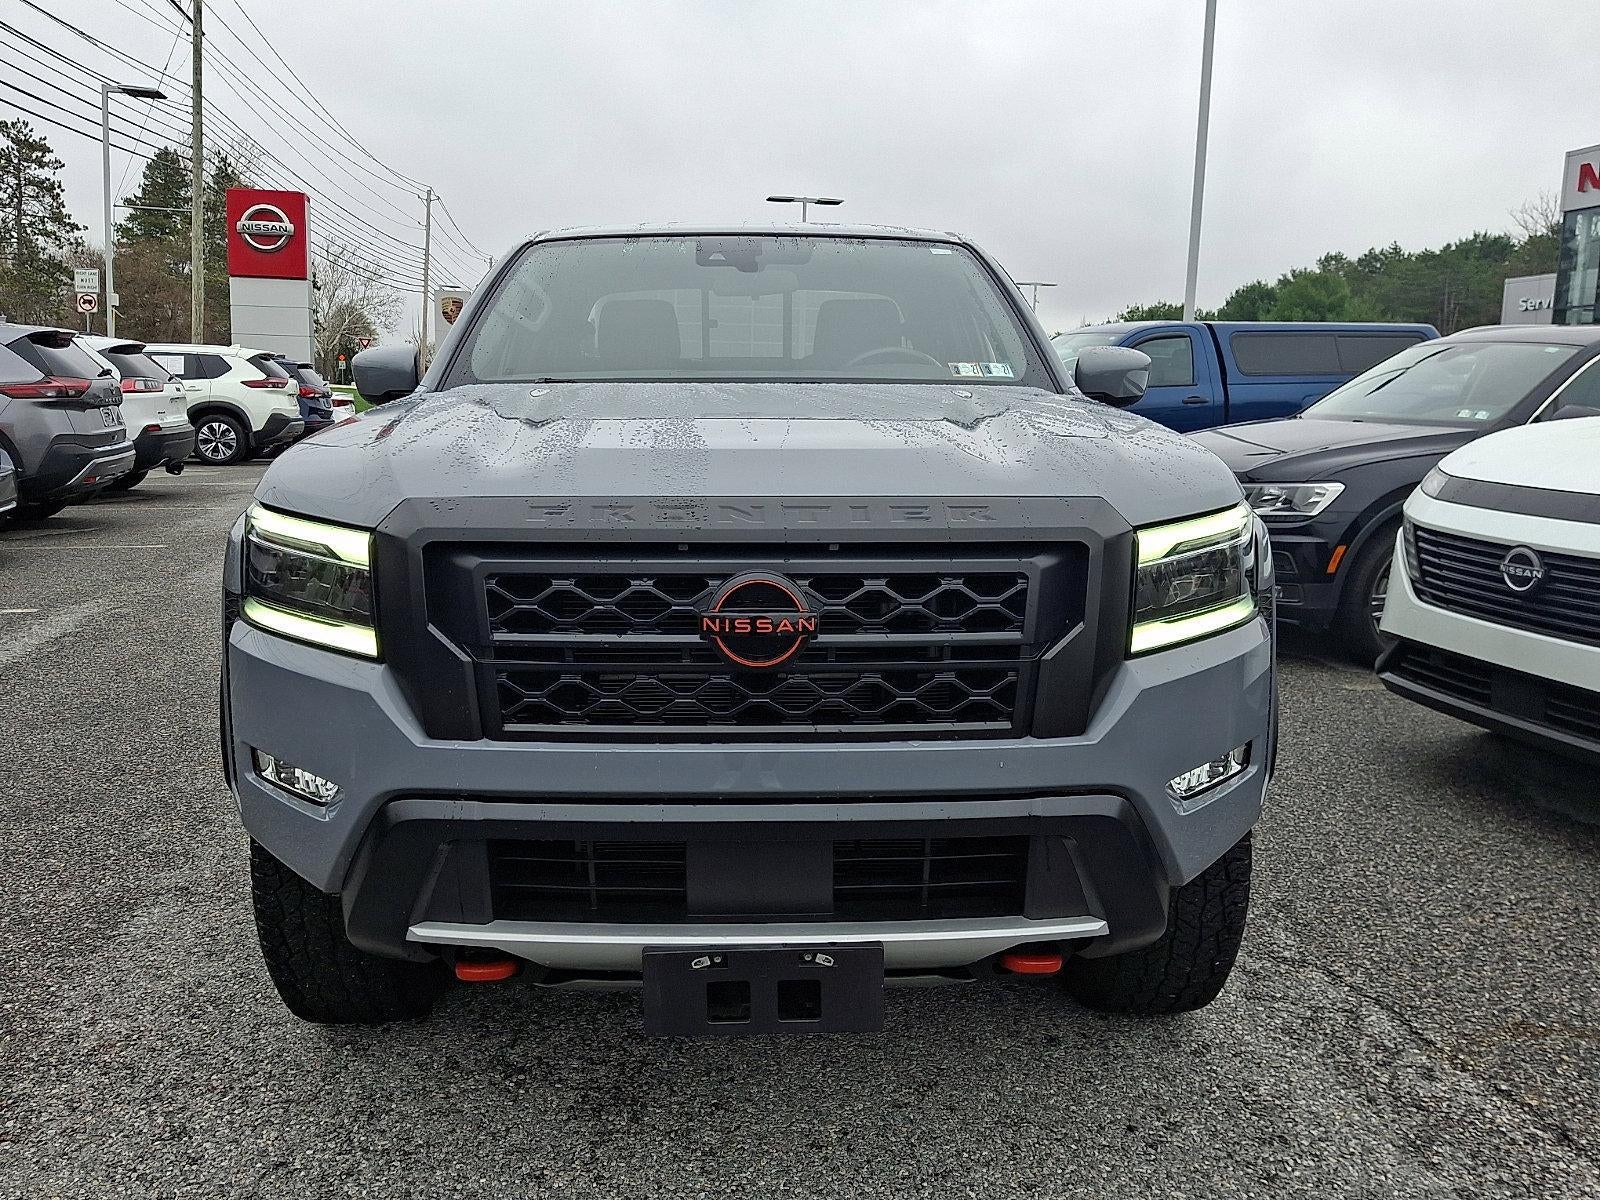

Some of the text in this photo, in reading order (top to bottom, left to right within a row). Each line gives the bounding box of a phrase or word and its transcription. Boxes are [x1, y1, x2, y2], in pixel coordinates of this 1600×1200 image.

[241, 223, 288, 232] NISSAN
[526, 505, 998, 523] FRONTIER
[1500, 564, 1543, 579] NISSAN
[703, 617, 816, 633] NISSAN
